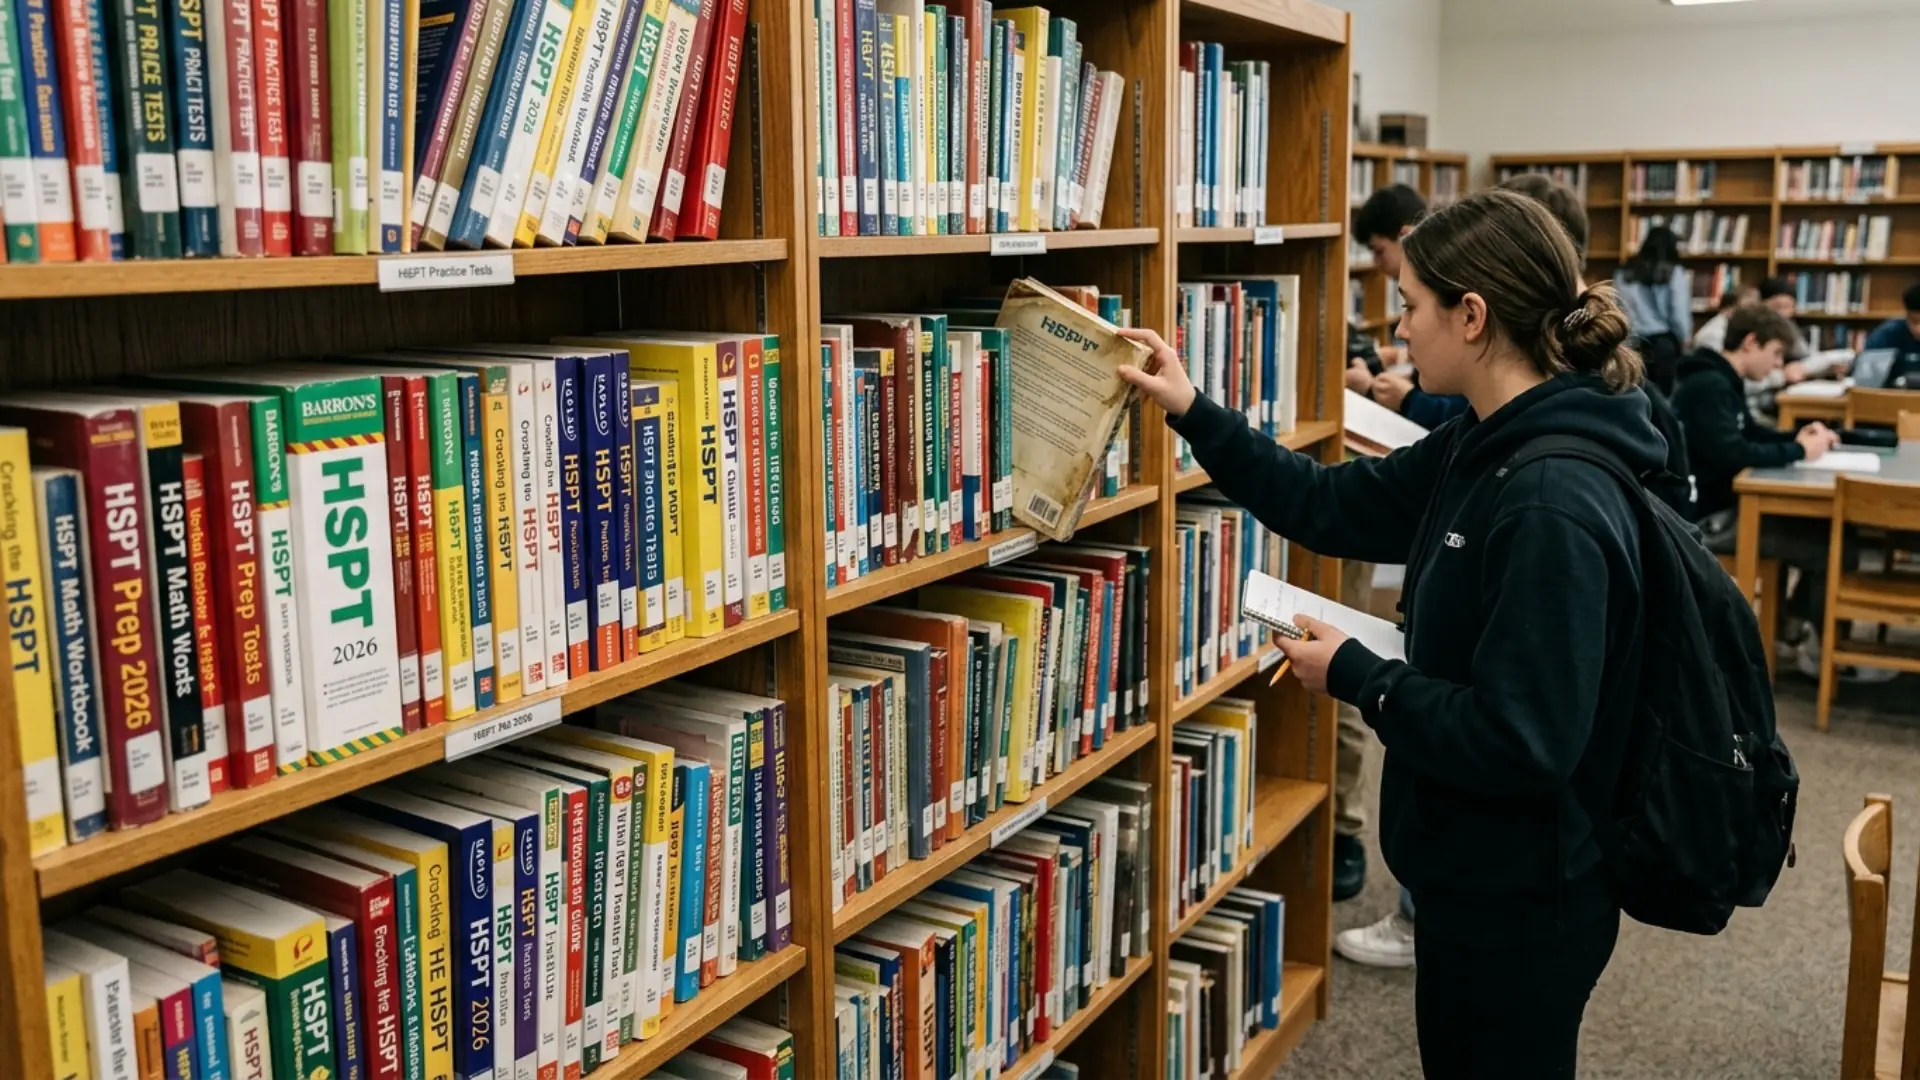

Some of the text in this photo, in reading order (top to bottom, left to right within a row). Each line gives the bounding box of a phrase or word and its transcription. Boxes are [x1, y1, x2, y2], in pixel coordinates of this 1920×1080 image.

[231, 0, 250, 26] PT
[261, 0, 280, 32] PT
[531, 21, 563, 97] HSPT
[429, 266, 467, 277] Practice
[301, 392, 377, 418] BARRON'S
[723, 389, 738, 464] HSPT
[564, 454, 582, 513] HSPT
[595, 448, 613, 513] HSPT
[701, 424, 718, 505] HSPT
[159, 481, 187, 558] HSPT
[230, 480, 256, 555] HSPT
[321, 456, 374, 628] HSPT
[523, 507, 540, 572] HSPT
[546, 491, 561, 554] HSPT
[235, 561, 257, 620] Prep
[271, 528, 293, 597] HSPT
[6, 578, 40, 674] HSPT
[104, 482, 152, 730] HSPT Prep 2026
[166, 565, 192, 630] Math
[55, 514, 95, 754] HSPT Math Workbook
[332, 636, 379, 666] 2026
[521, 887, 536, 937] HSPT
[544, 871, 560, 926] HSPT
[497, 904, 513, 965] HSPT
[470, 916, 491, 1051] HSPT 2026
[303, 976, 330, 1057] HSPT
[377, 1014, 399, 1075] HSPT
[430, 985, 449, 1053] HSPT
[243, 1026, 264, 1080] HSPT
